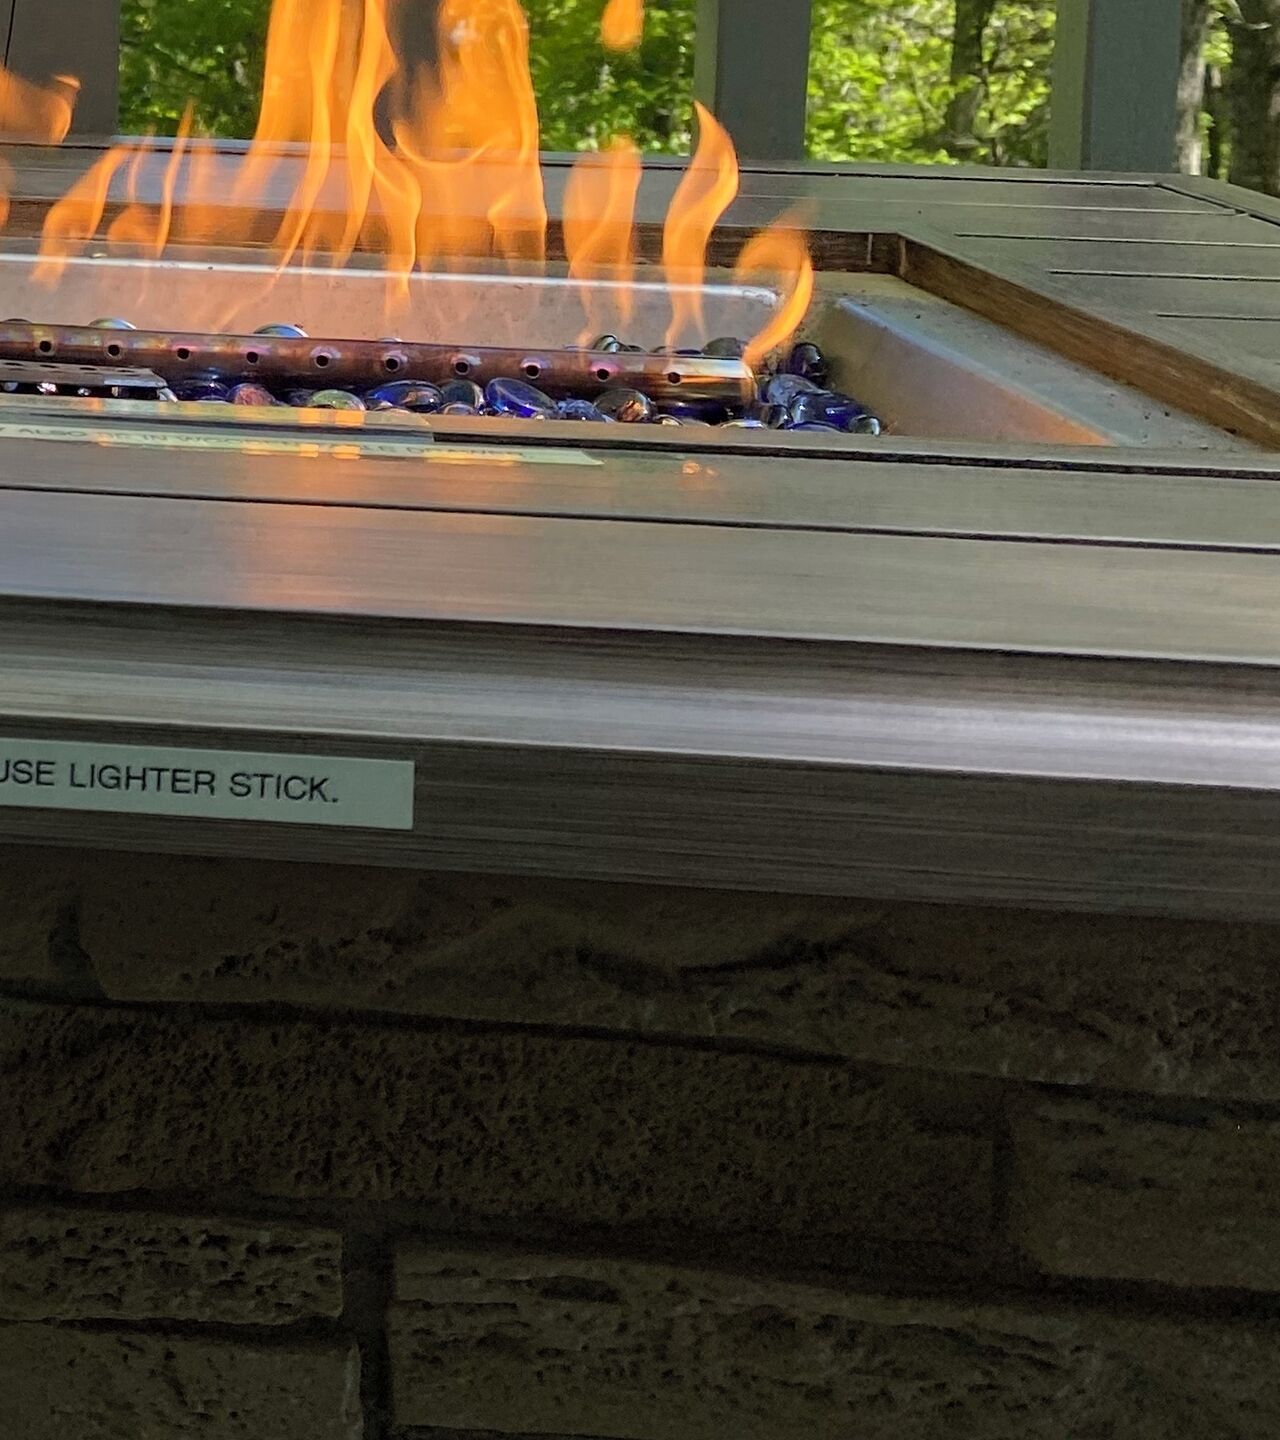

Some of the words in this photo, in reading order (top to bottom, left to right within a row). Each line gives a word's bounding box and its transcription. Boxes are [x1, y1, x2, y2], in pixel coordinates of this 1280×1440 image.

[18, 428, 88, 437] ALSO
[70, 763, 216, 796] LIGHTER
[229, 771, 338, 803] STICK.
